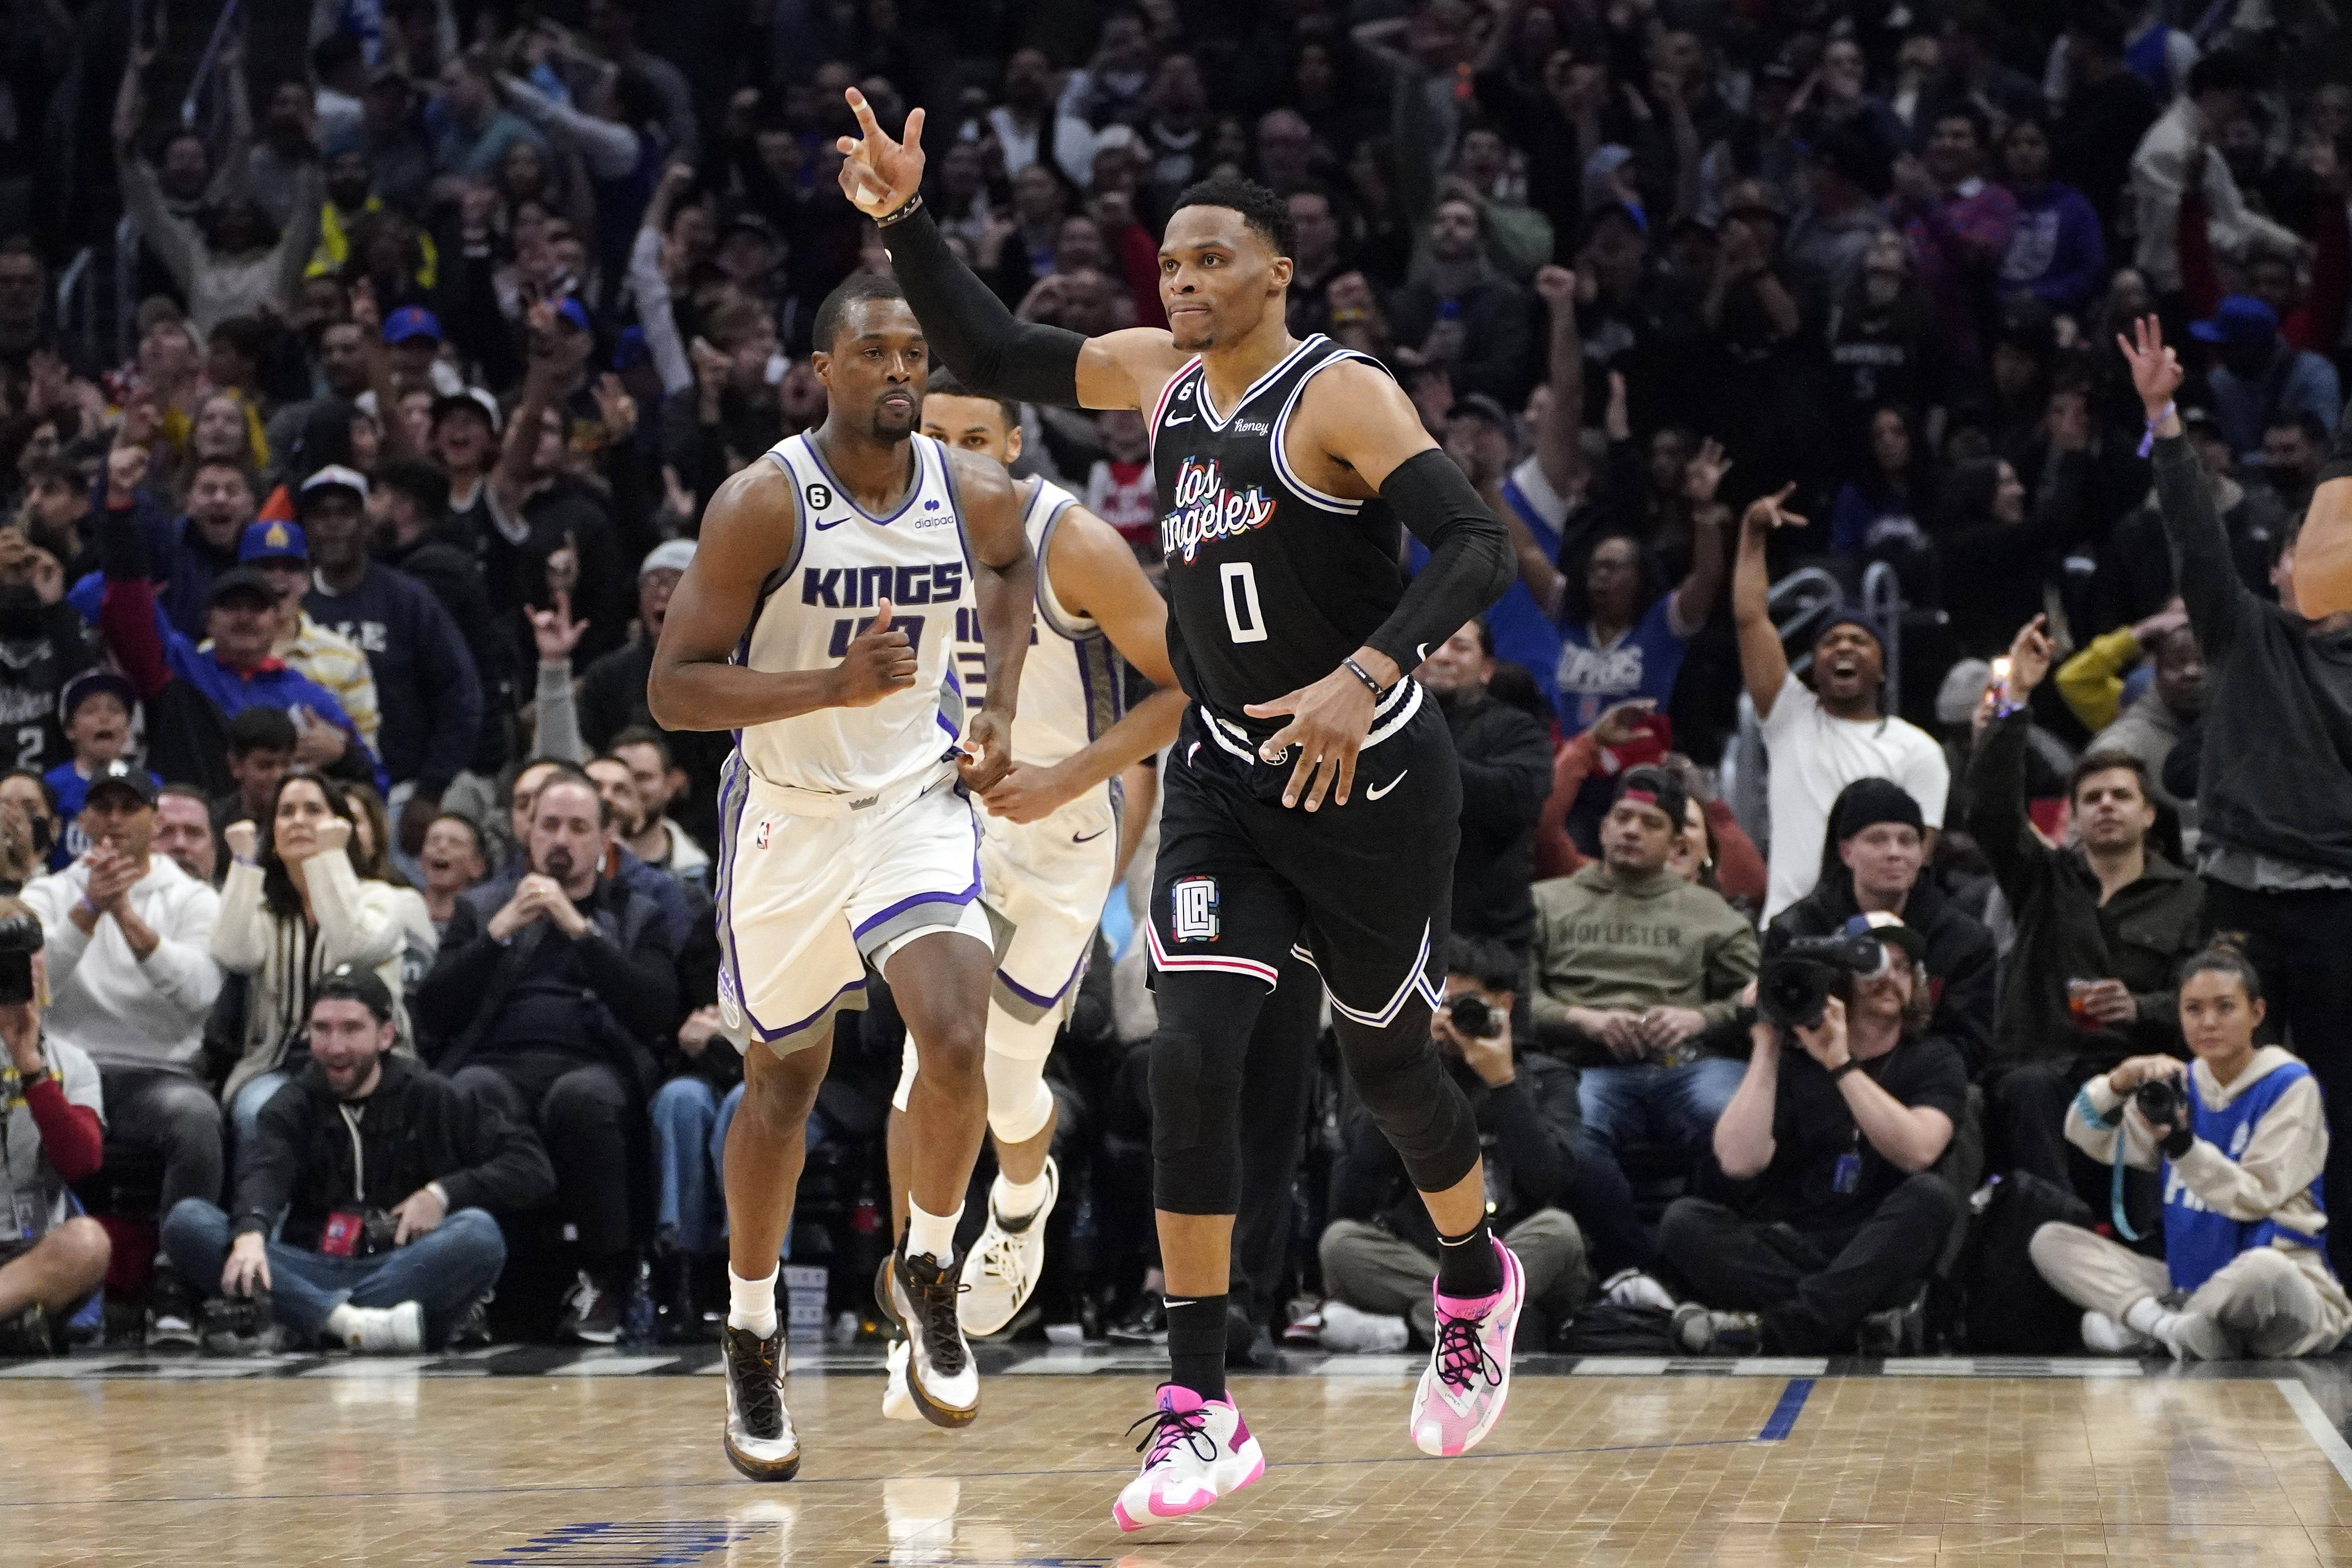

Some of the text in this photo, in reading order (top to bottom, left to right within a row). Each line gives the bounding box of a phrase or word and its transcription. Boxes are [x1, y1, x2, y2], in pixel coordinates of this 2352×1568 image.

[1178, 381, 1195, 401] 6
[1234, 418, 1269, 436] honey
[1175, 461, 1221, 508] los
[809, 486, 826, 508] 6
[914, 514, 954, 529] dialpad
[801, 560, 962, 609] KINGS
[1219, 561, 1268, 644] 0
